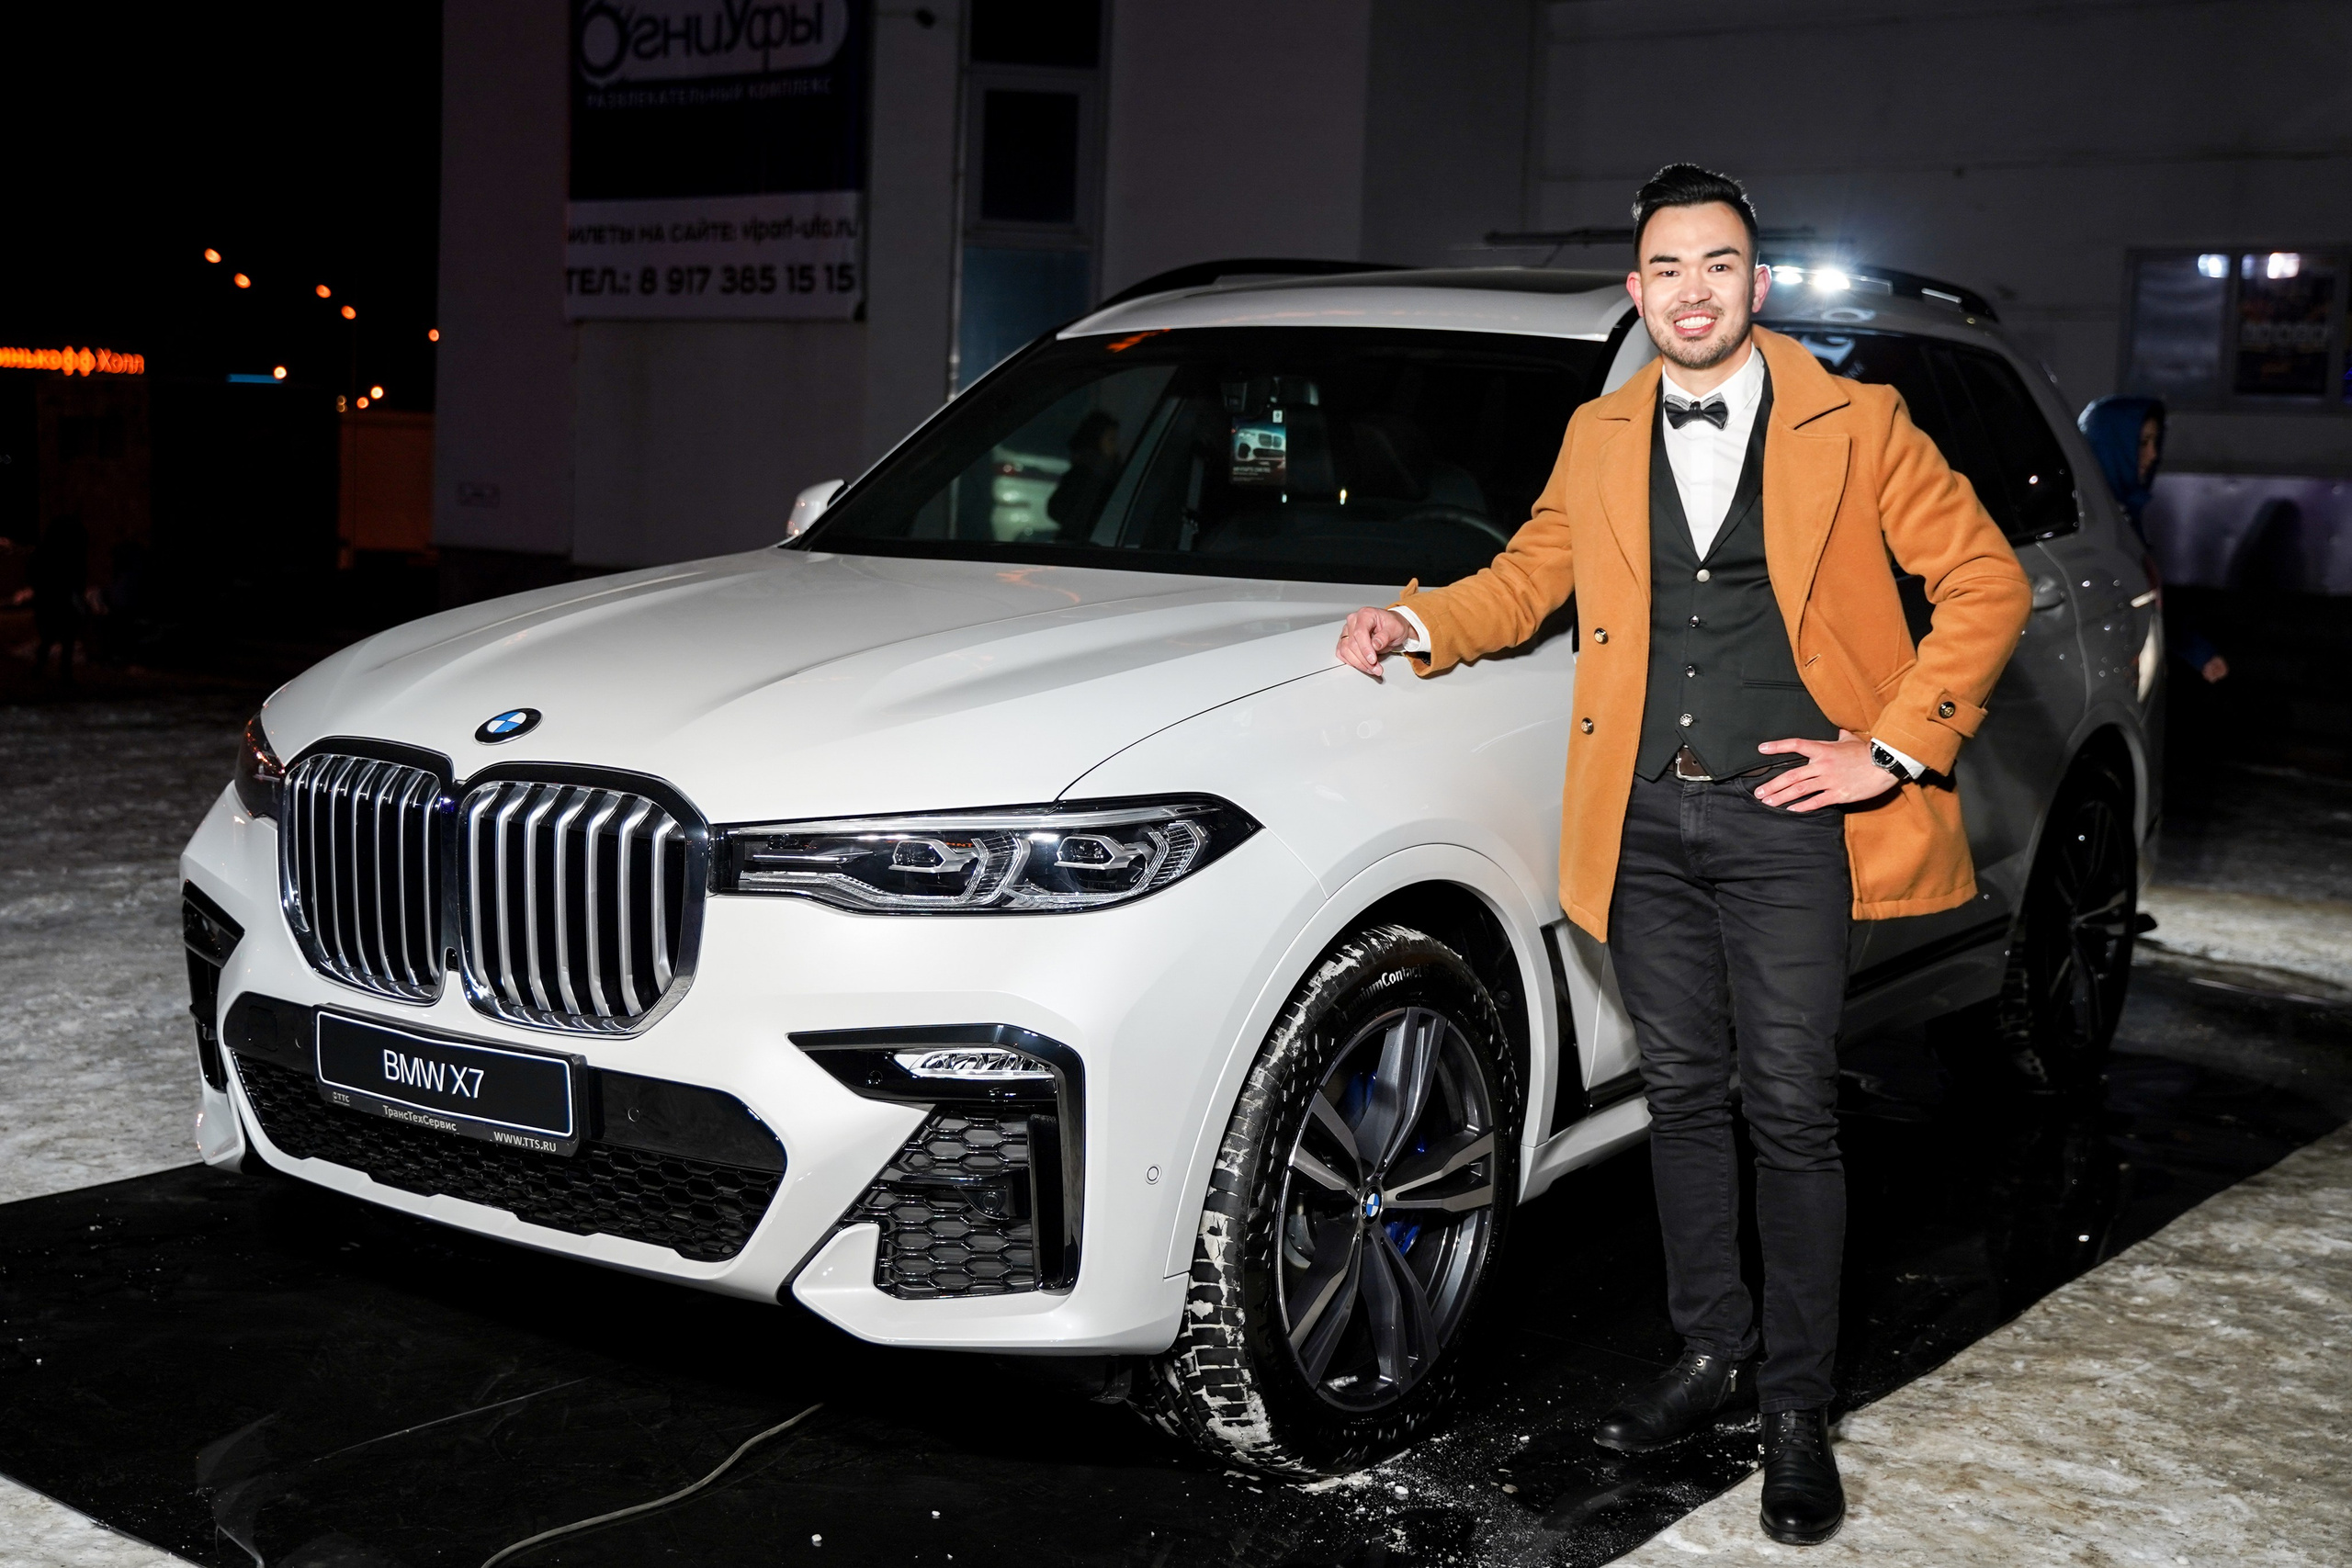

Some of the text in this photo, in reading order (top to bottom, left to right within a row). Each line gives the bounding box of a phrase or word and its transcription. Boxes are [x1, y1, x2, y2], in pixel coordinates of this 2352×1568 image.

[748, 74, 832, 101] КОМПЛЕКС
[639, 222, 665, 243] НА
[639, 265, 657, 296] 8
[666, 265, 712, 296] 917
[718, 265, 777, 296] 385
[786, 264, 816, 295] 15
[823, 263, 855, 295] 15
[96, 347, 144, 375] Холл
[383, 1048, 485, 1099] BMW X7
[382, 1104, 458, 1132] ТрансТехСервис
[493, 1131, 557, 1153] WWW.TTS.RU
